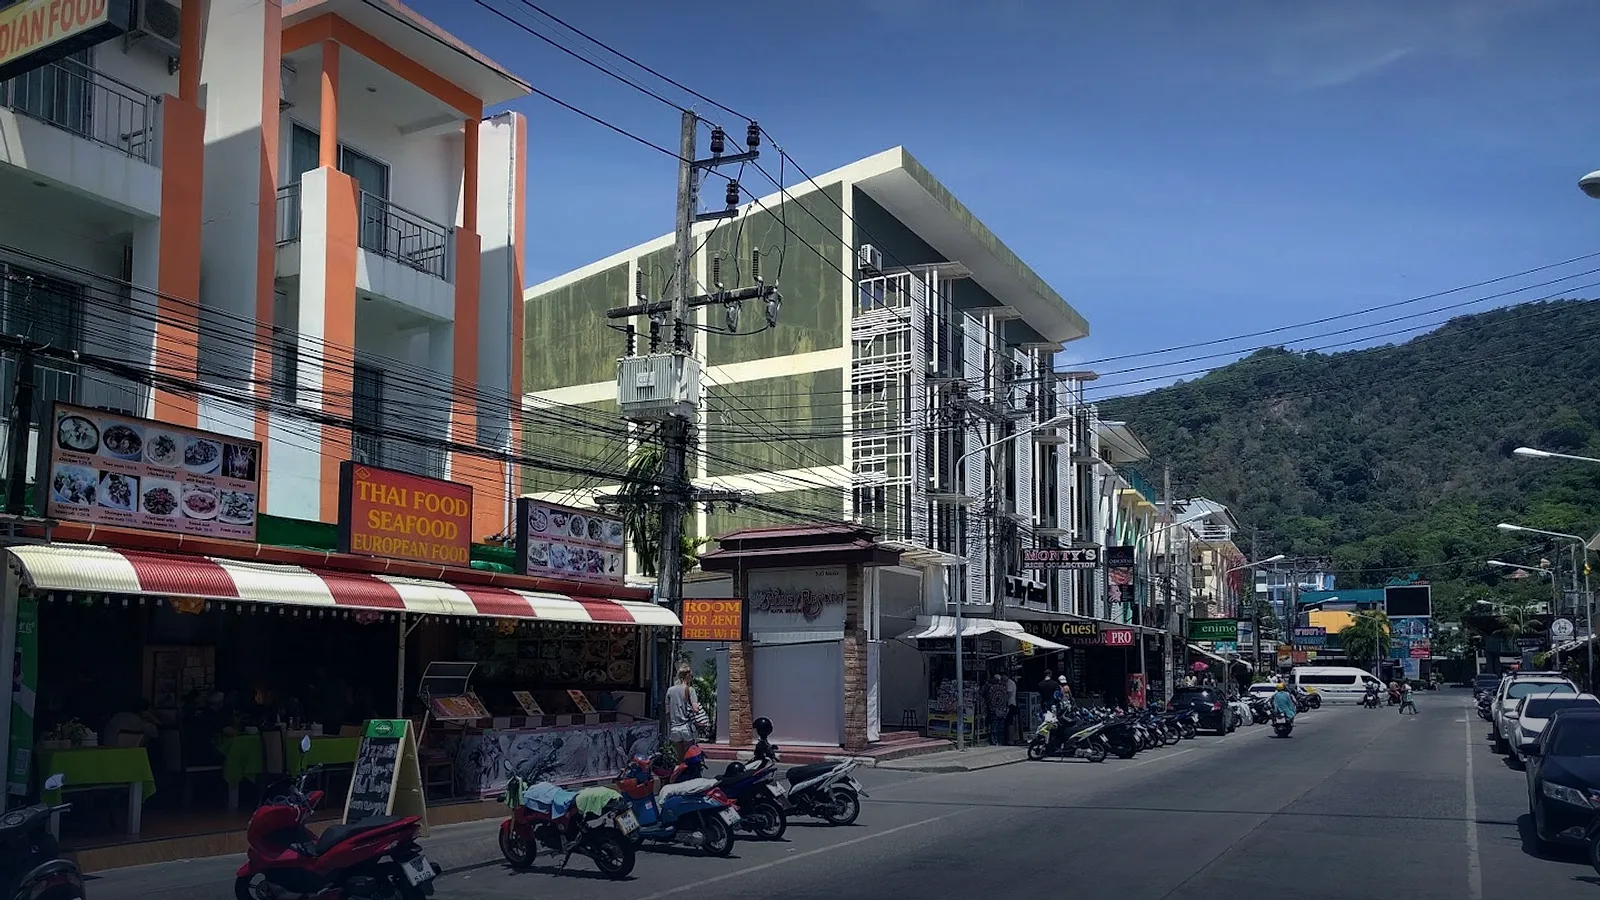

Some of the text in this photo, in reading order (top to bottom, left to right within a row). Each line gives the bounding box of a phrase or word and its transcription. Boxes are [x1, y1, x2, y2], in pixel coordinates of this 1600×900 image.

[48, 0, 105, 39] FOOD
[356, 480, 469, 517] THAI FOOD
[367, 509, 458, 541] SEAFOOD
[352, 533, 468, 563] EUROPEAN FOOD
[1024, 548, 1097, 562] MONTY'S
[685, 602, 740, 613] ROOM
[685, 614, 739, 626] FOR RENT
[685, 628, 711, 638] FREE
[1025, 622, 1097, 638] Be My Guest
[1201, 623, 1237, 633] enimo
[1111, 631, 1132, 645] PRO
